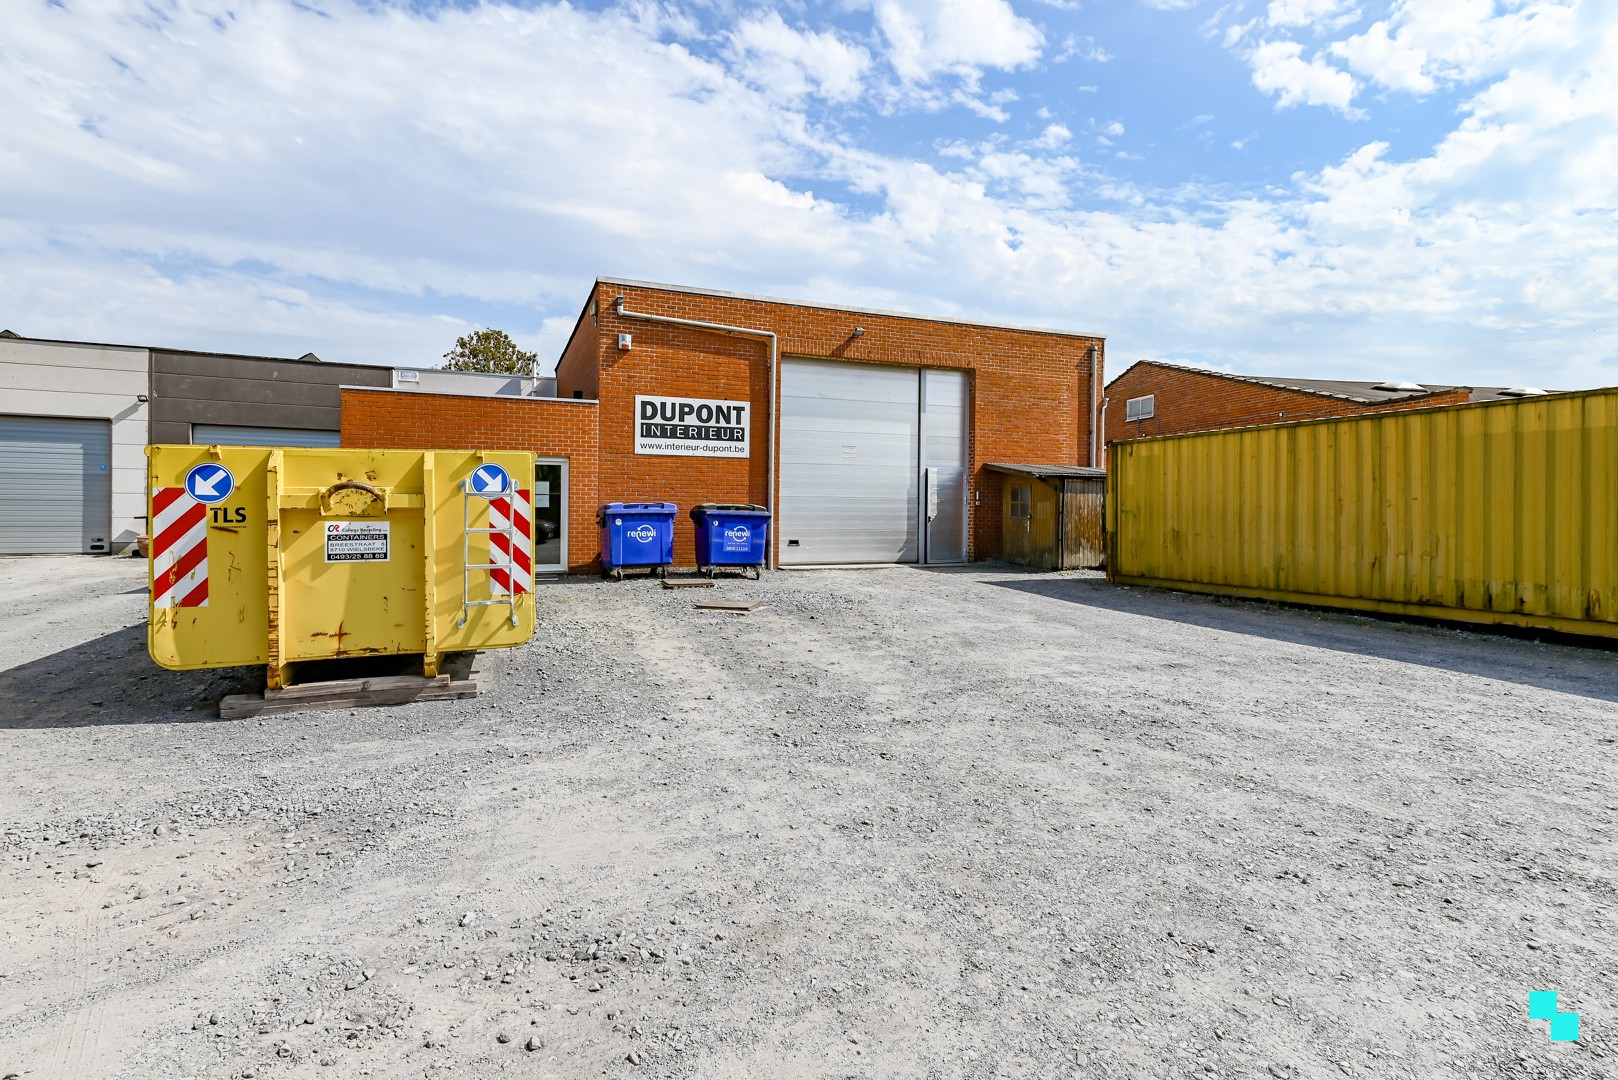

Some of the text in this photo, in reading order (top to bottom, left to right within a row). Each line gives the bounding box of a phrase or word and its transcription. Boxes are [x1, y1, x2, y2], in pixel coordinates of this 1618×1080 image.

[640, 400, 745, 425] DUPONT
[643, 425, 742, 440] INTERIEUR
[640, 442, 744, 453] www.interieur-dupont.be
[210, 507, 246, 523] TLS
[628, 528, 656, 539] renewi
[725, 529, 750, 538] renewi
